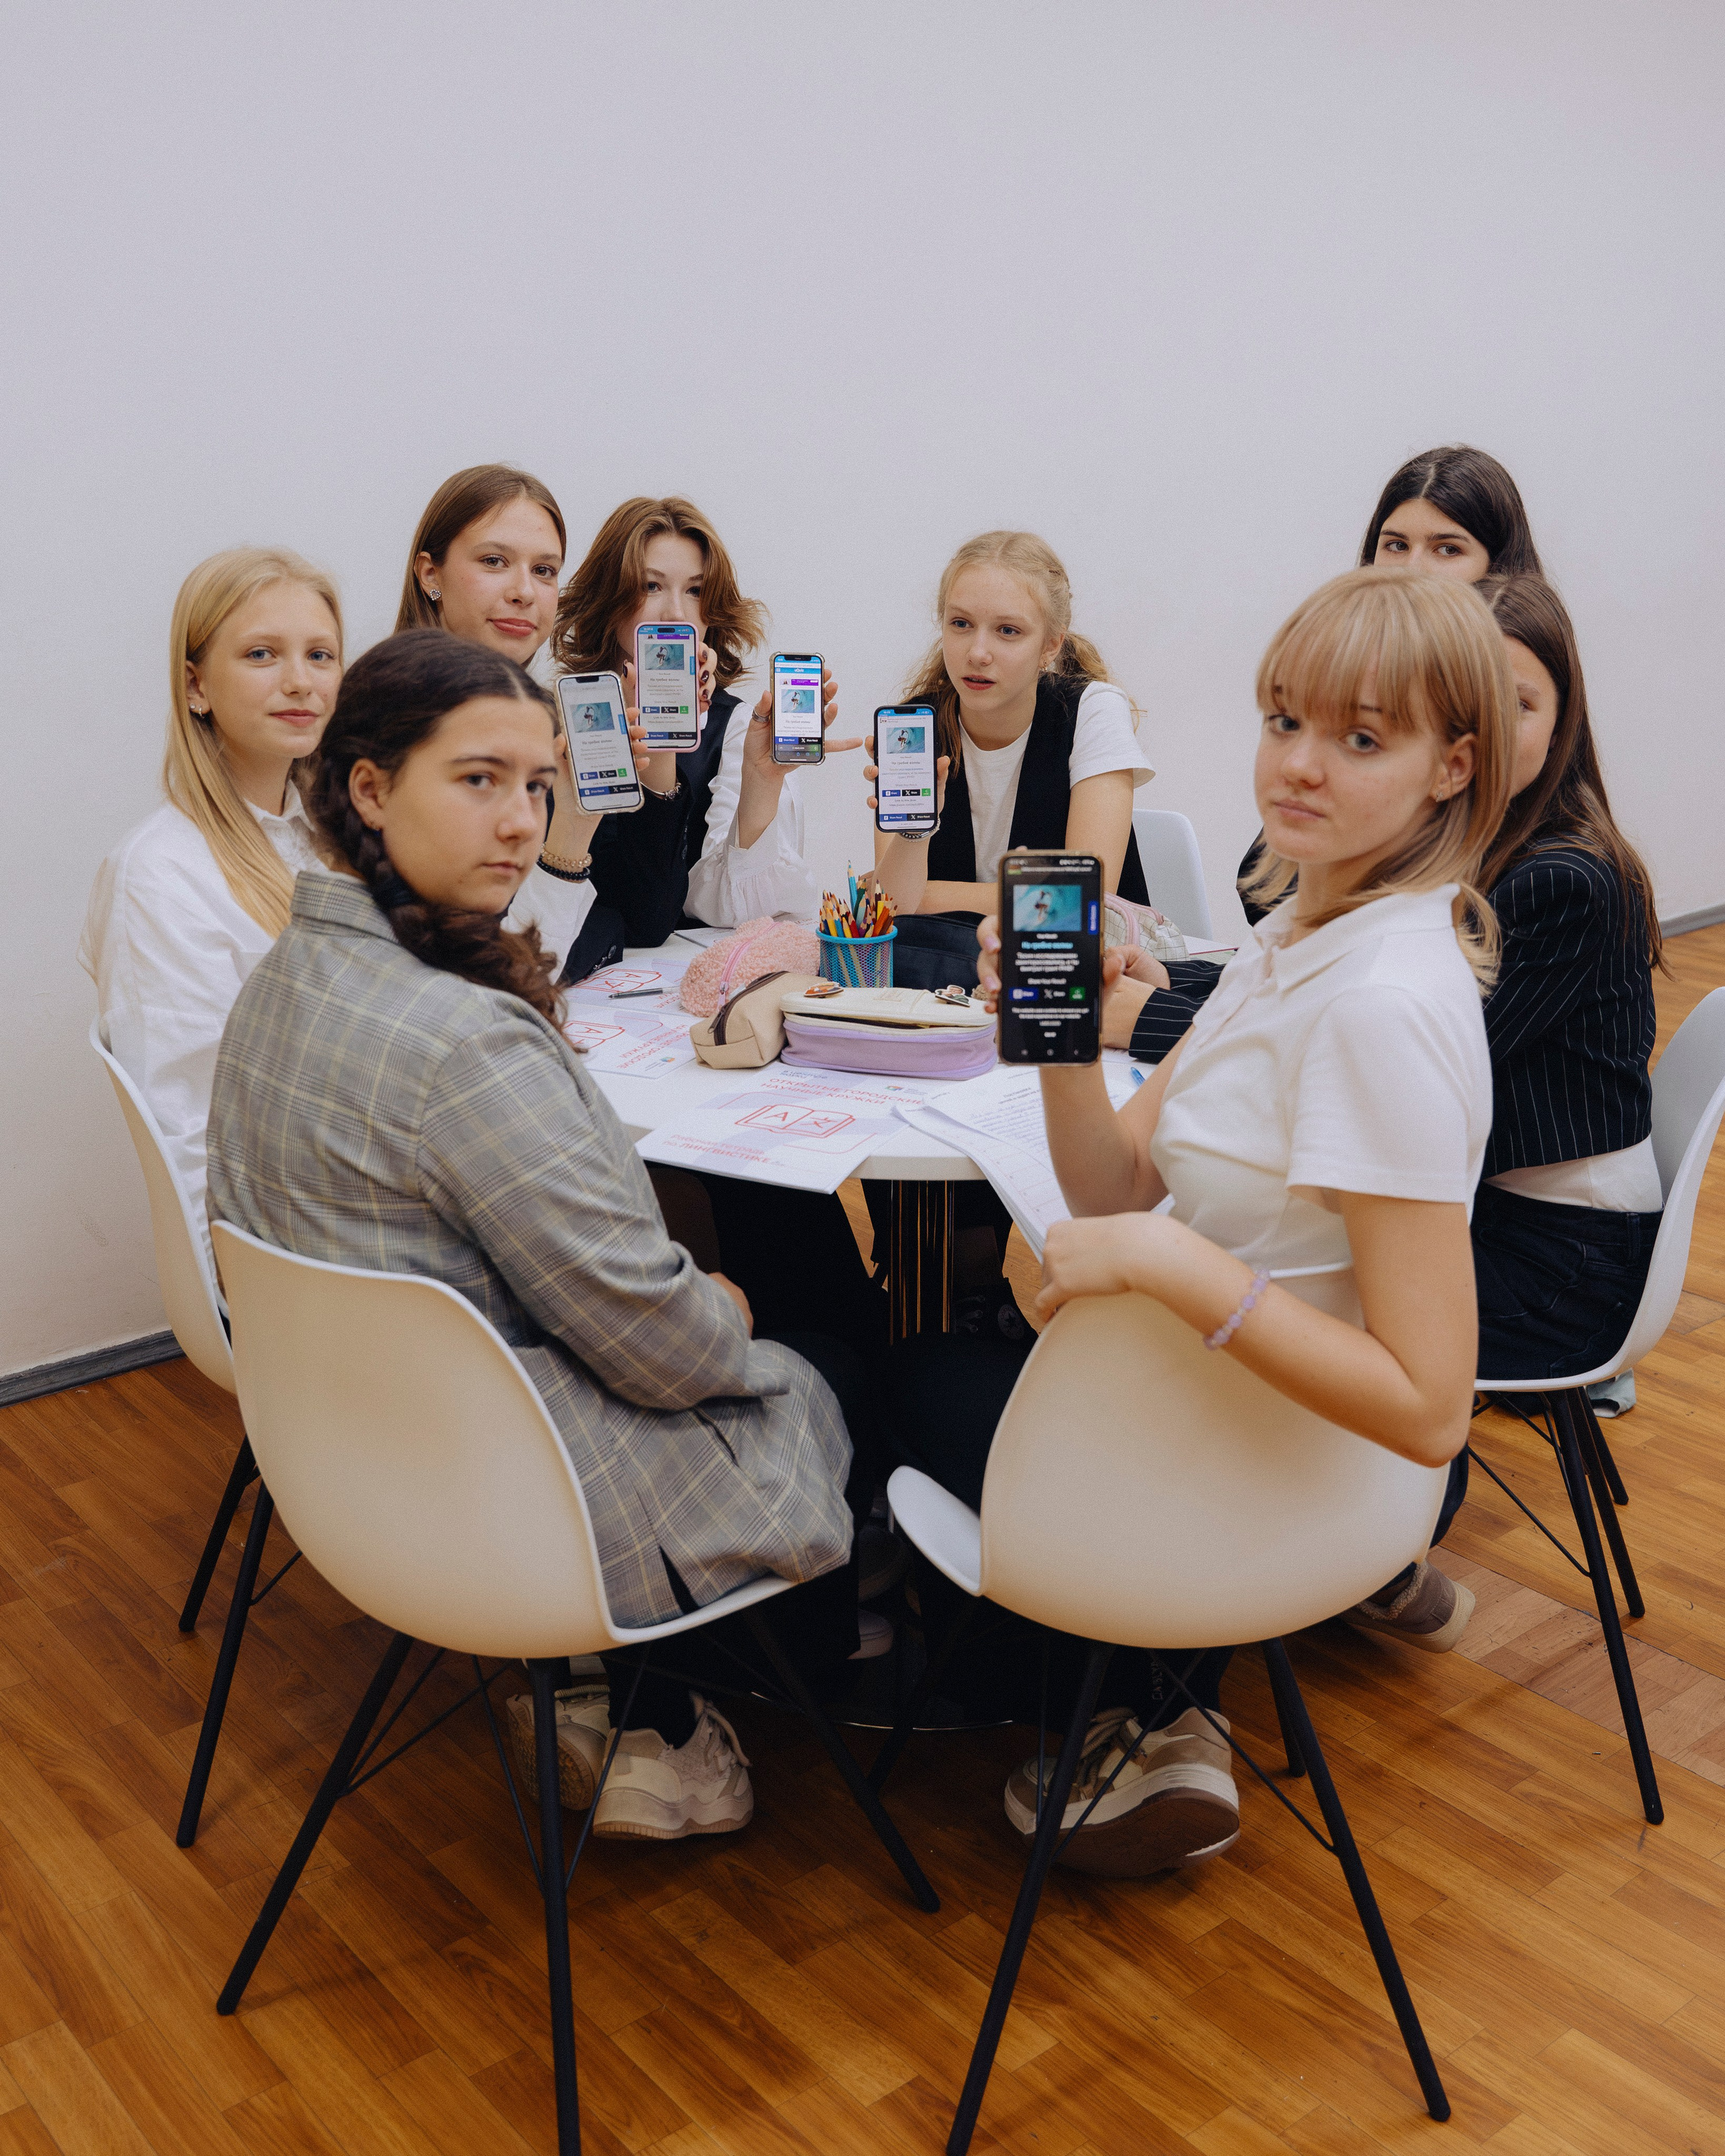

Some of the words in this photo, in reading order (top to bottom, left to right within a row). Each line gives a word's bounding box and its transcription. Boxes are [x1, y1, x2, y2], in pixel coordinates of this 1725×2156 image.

[760, 1083, 823, 1096] НАУЧНЫЕ
[826, 1093, 886, 1105] КРУЖКИ
[770, 1078, 842, 1092] ОТКРЫТЫЕ
[844, 1089, 923, 1104] ГОРОДСКИЕ
[679, 1143, 772, 1163] ЛИНГВИСТИКЕ
